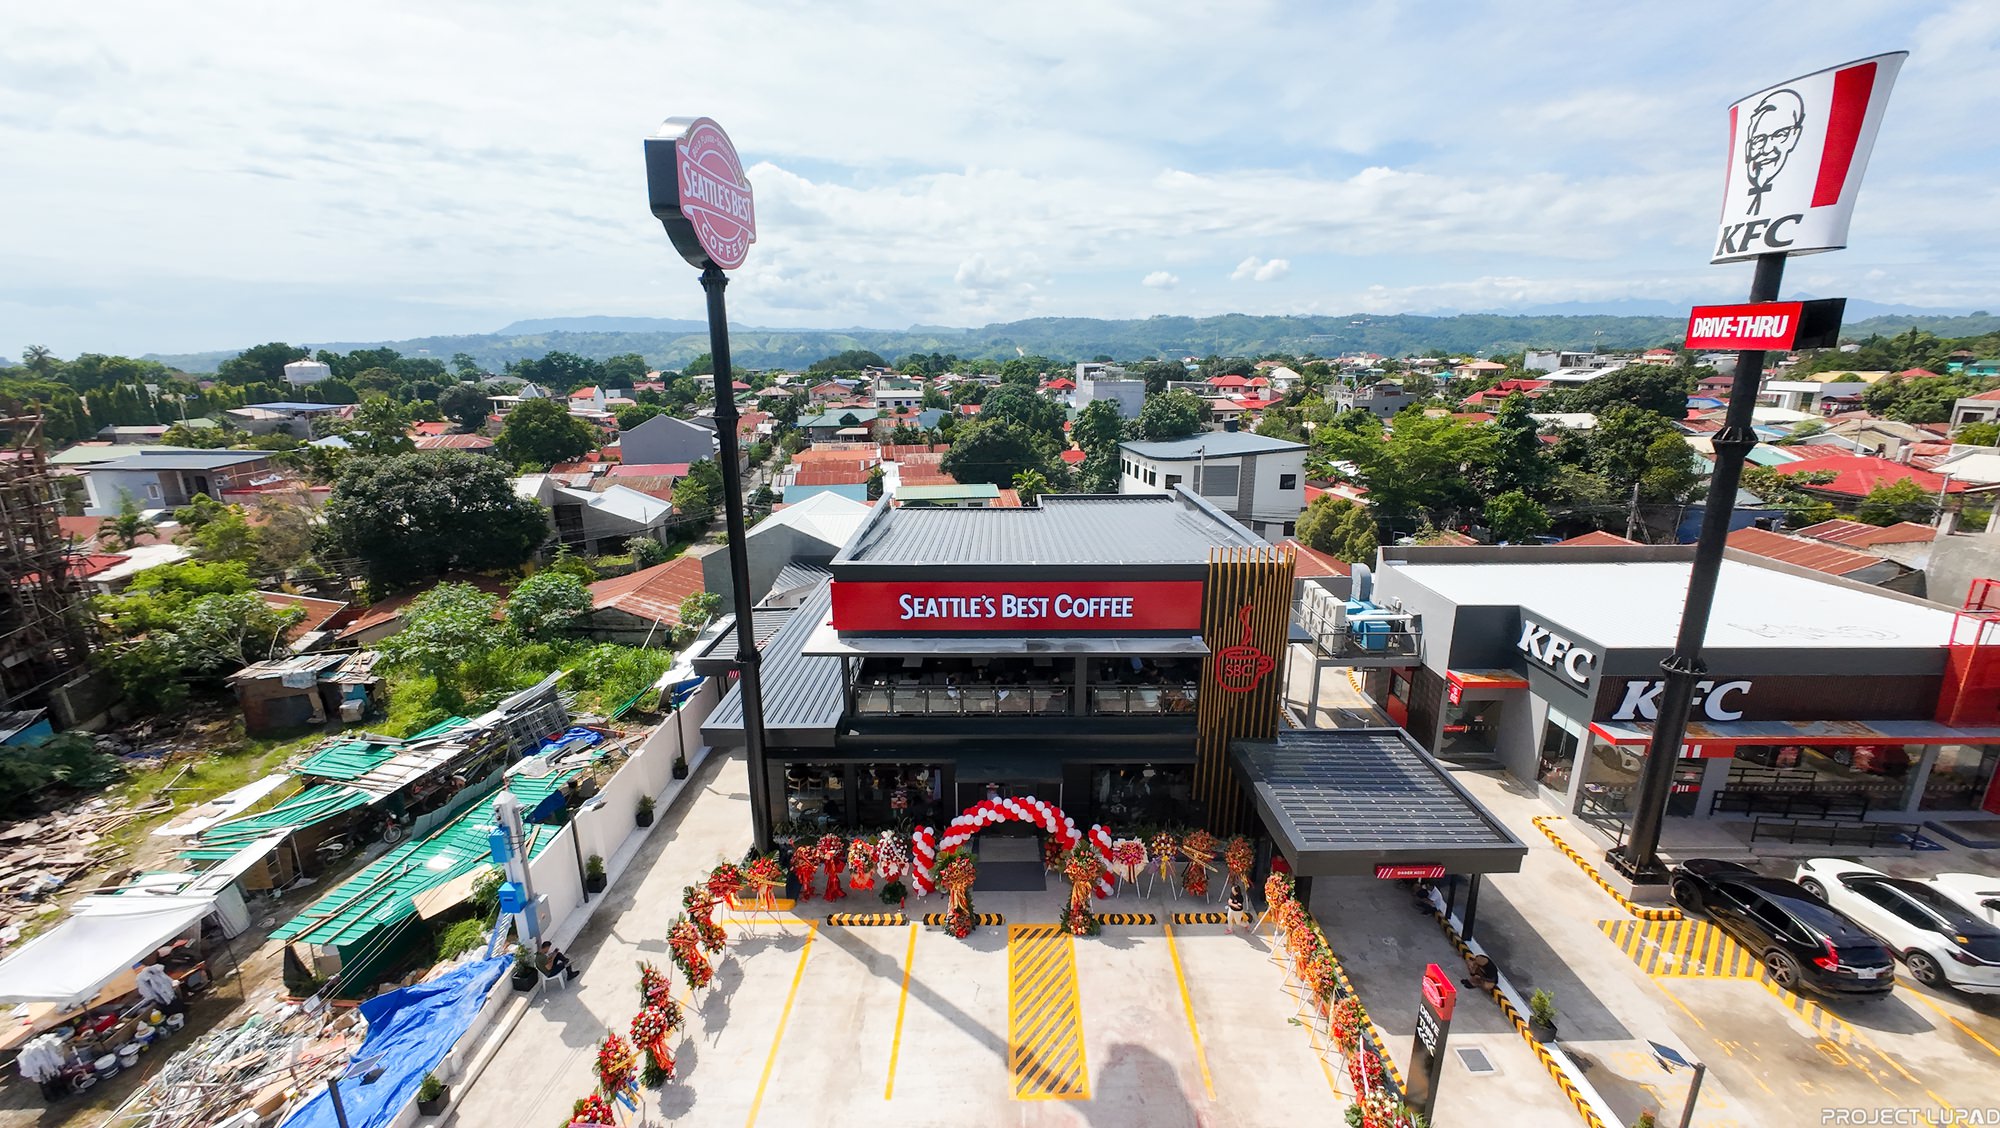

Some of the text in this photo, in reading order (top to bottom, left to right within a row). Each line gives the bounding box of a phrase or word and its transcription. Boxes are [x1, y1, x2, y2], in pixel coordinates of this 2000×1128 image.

[682, 160, 733, 214] SEATTLE'S
[731, 189, 753, 225] BEST
[702, 222, 745, 259] COFFEE
[1716, 213, 1804, 256] KFC
[1691, 314, 1790, 338] DRIVE-THRU
[899, 593, 1134, 620] SEATTLE'S BEST COFFEE
[1516, 619, 1594, 684] KFC
[1225, 664, 1253, 677] SBC
[1419, 1003, 1440, 1037] DRIVE
